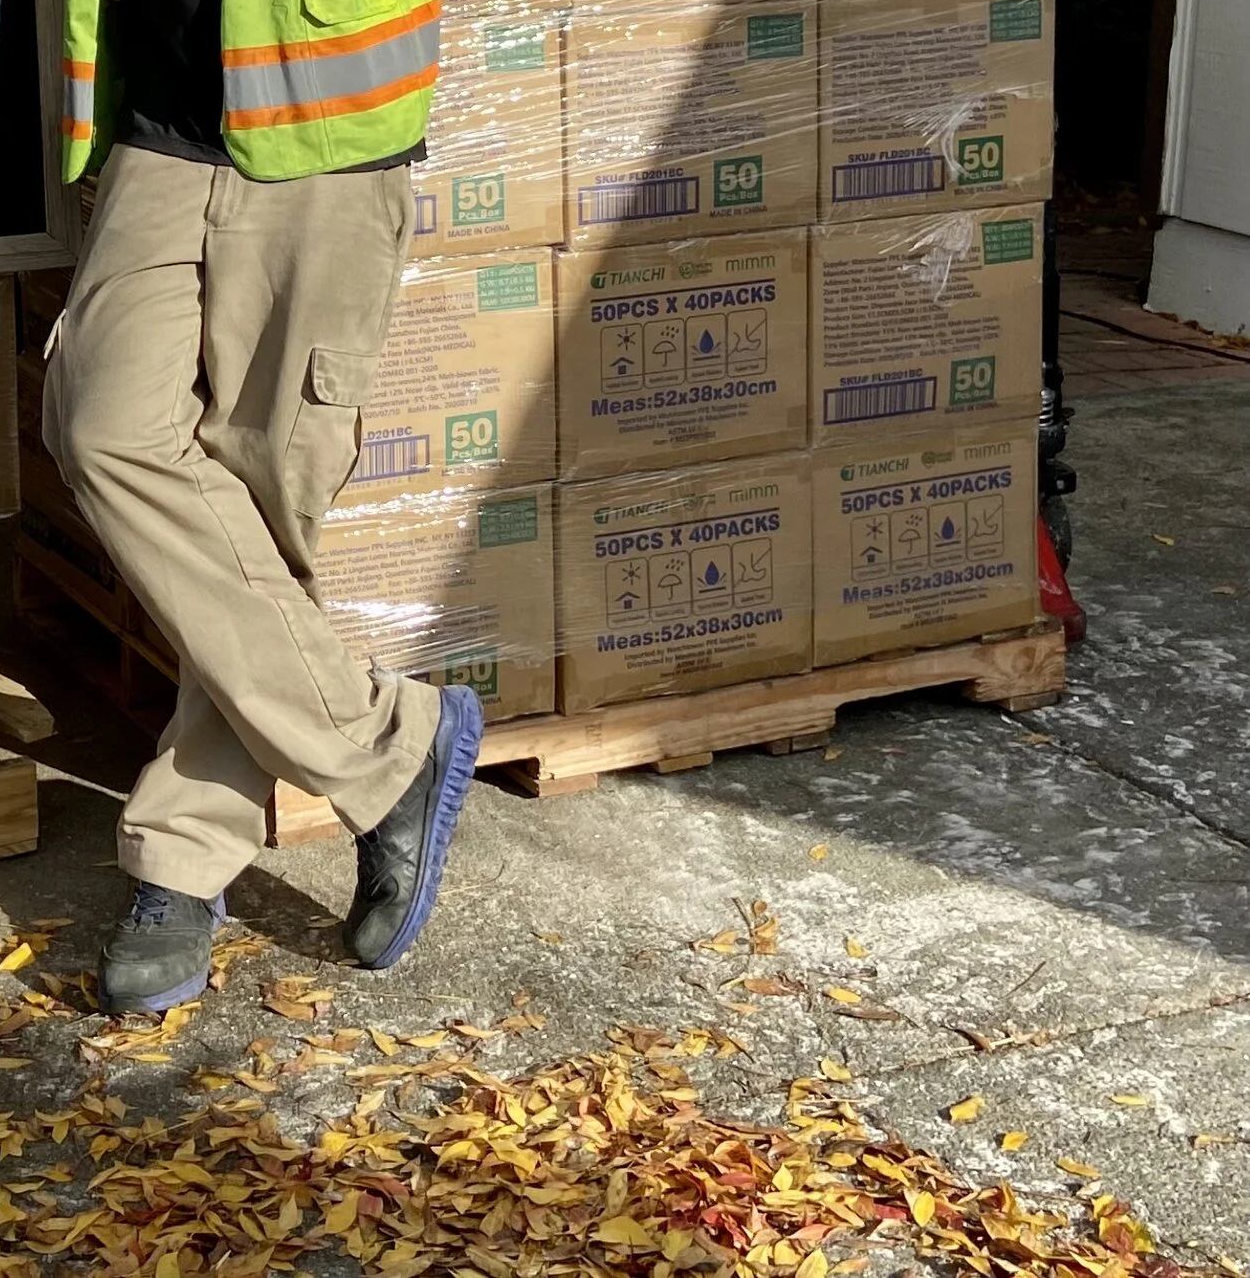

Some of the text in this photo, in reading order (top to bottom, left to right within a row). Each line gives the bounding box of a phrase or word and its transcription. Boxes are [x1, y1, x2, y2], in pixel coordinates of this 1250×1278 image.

[963, 141, 999, 170] 50
[719, 162, 757, 192] 50
[458, 178, 499, 211] 50
[448, 227, 473, 238] MADE
[484, 224, 510, 234] CHINA
[609, 268, 666, 285] TIANCHI
[591, 284, 776, 323] 50PCS X 40PACKS
[956, 362, 992, 390] 50
[591, 379, 777, 417] Meas:52x38x30cm
[451, 417, 493, 449] 50
[452, 446, 493, 459] Pcs/Box
[858, 458, 909, 477] TIANCHI
[841, 472, 1012, 515] 50PCS X 40PACKS
[595, 514, 780, 558] 50PCS X 40PACKS
[842, 562, 1013, 605] Meas:52x38x30cm
[597, 608, 782, 652] Meas:52x38x30cm
